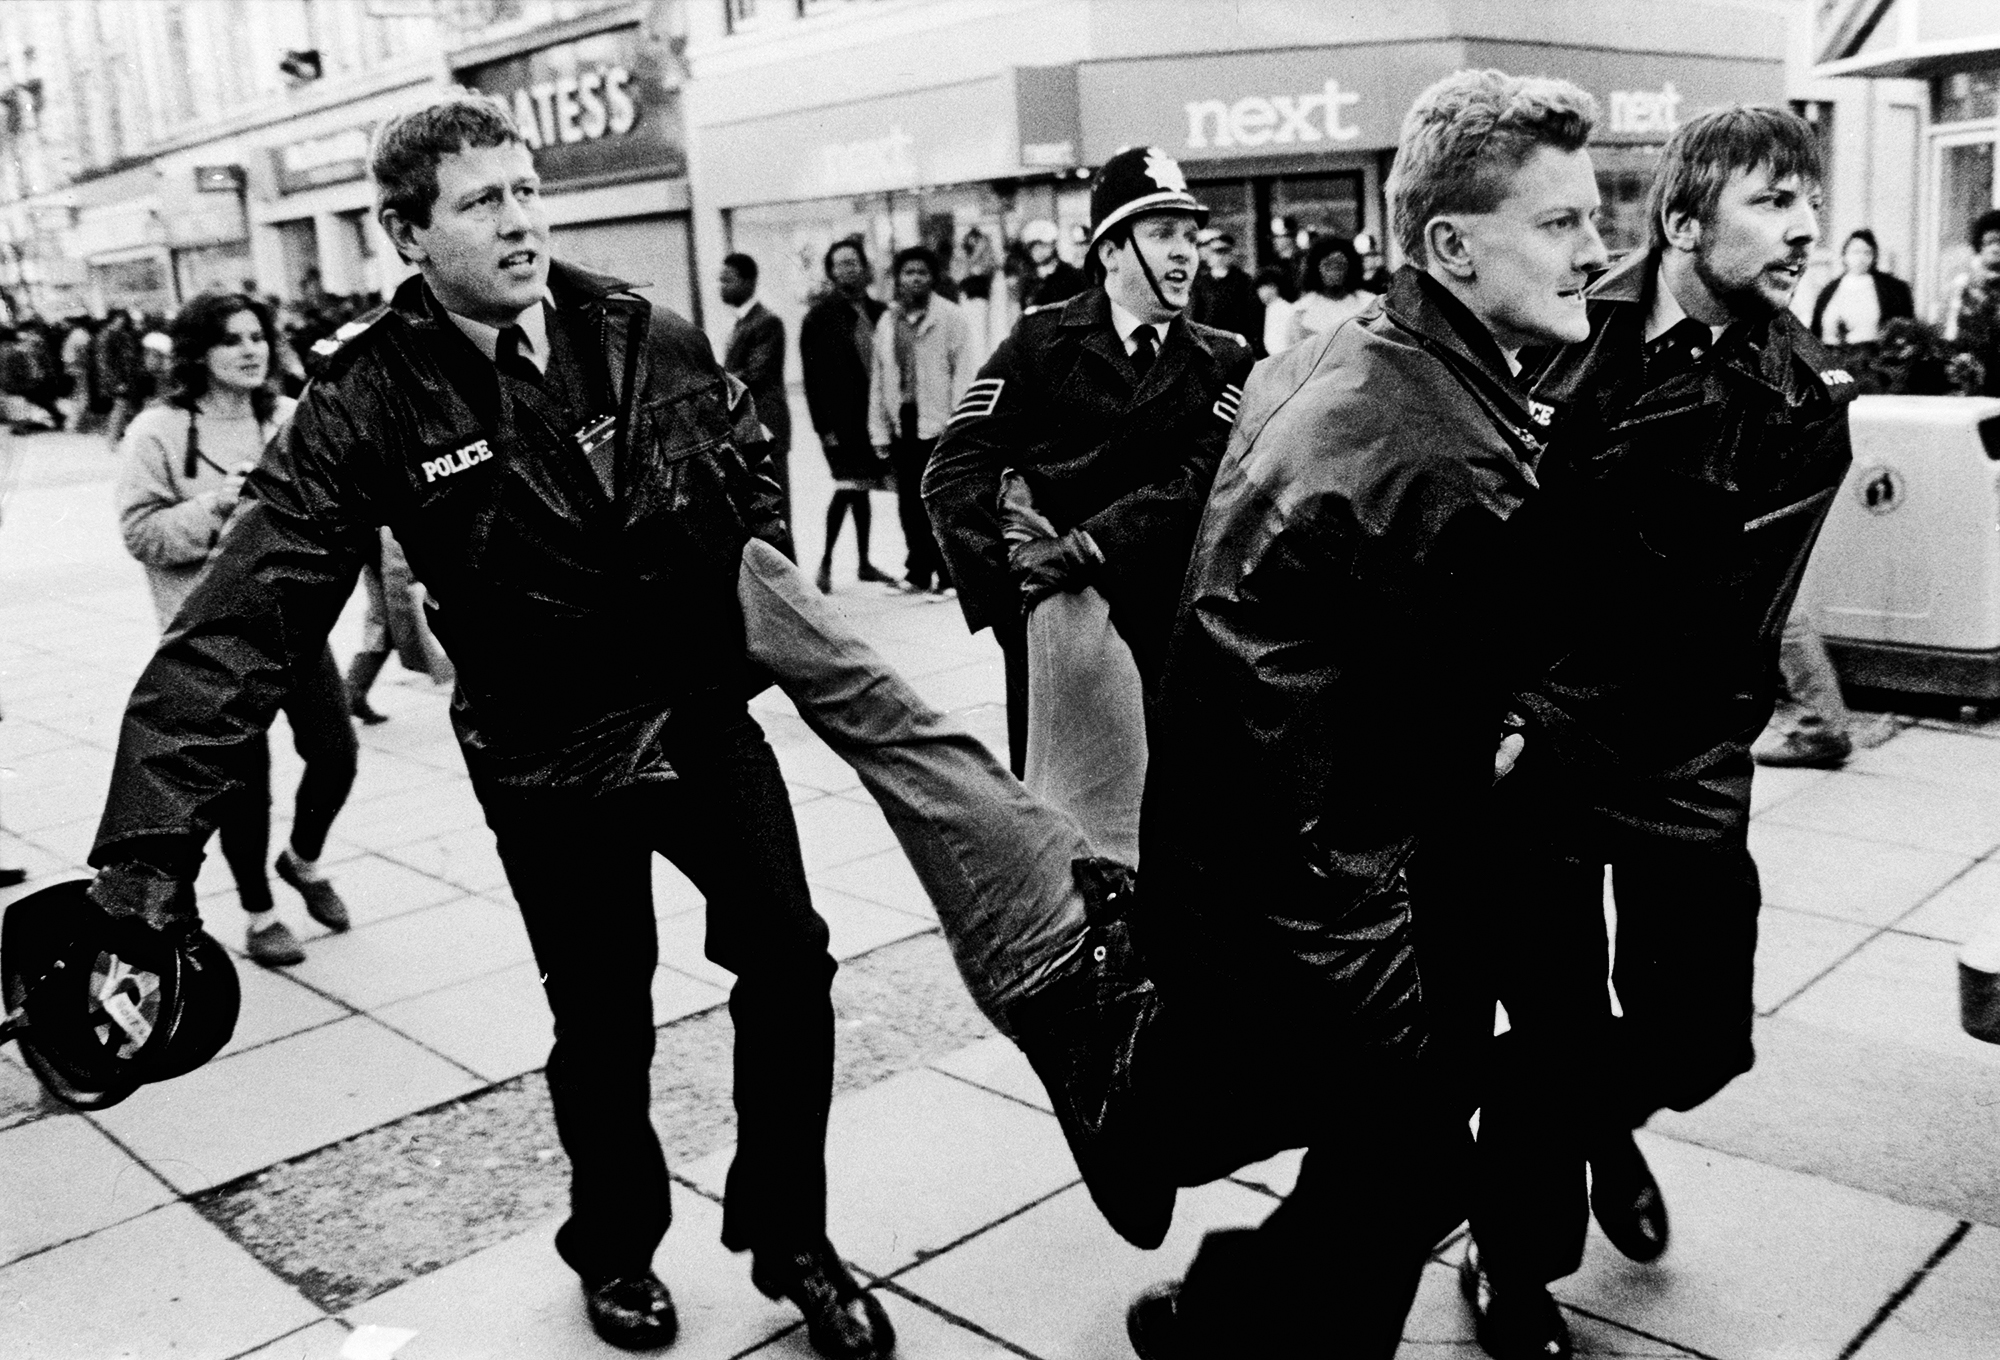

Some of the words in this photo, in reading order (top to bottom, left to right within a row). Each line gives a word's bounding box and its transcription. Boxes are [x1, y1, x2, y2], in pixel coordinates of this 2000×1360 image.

[1184, 78, 1361, 147] next
[1610, 81, 1682, 133] next
[421, 439, 494, 483] POLICE
